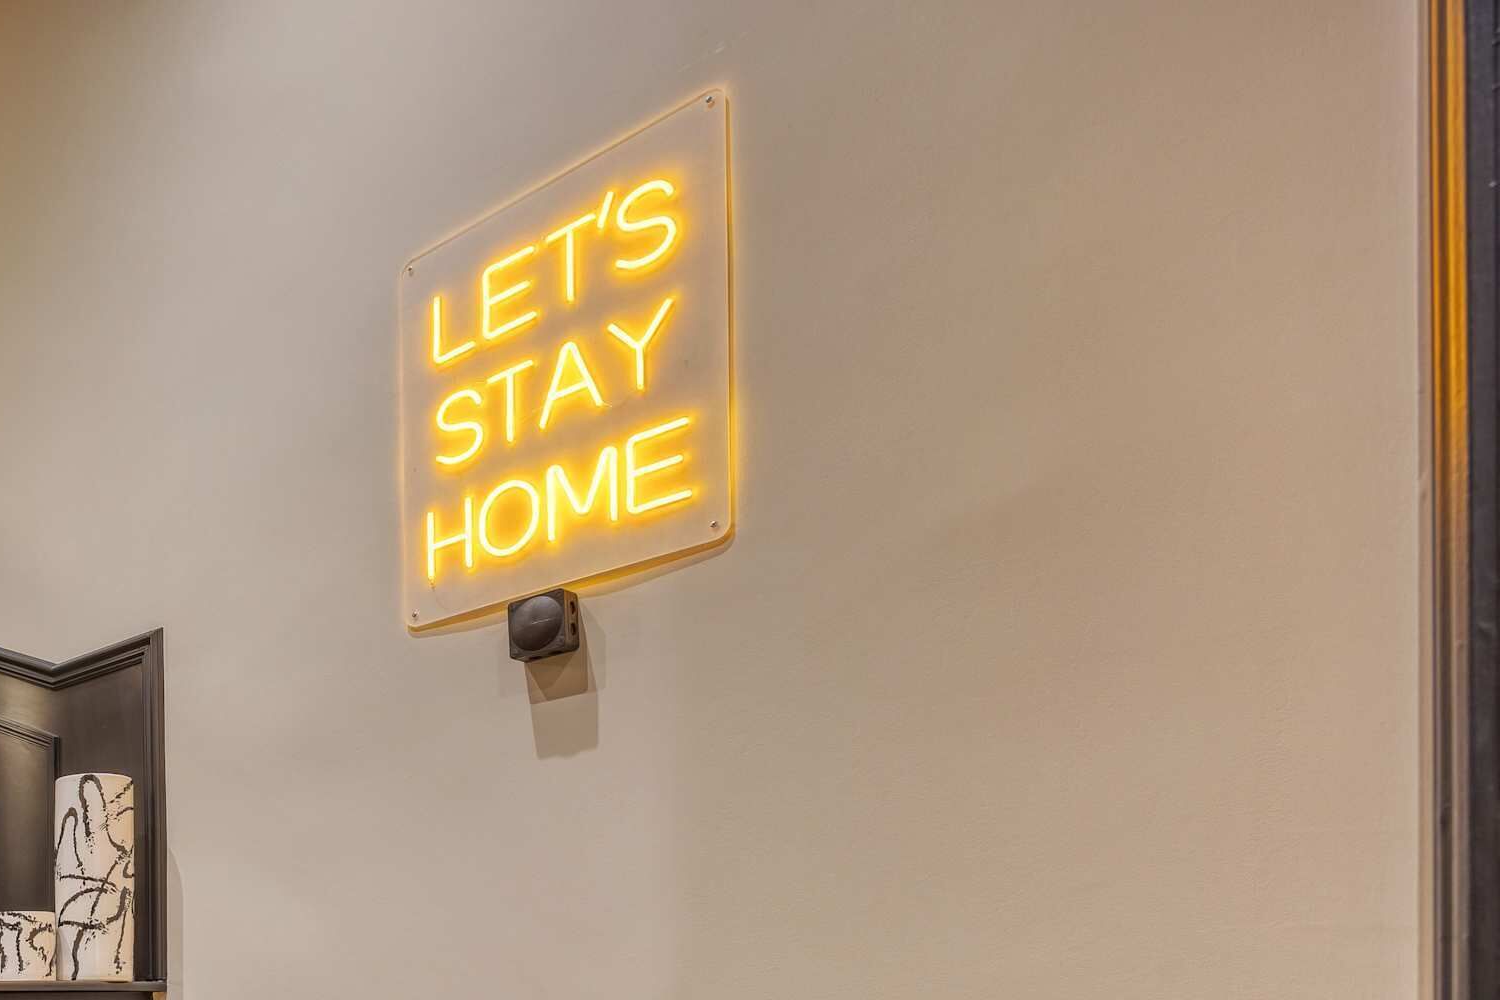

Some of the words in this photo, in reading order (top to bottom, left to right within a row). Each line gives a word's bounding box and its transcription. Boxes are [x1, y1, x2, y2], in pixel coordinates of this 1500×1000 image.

[431, 178, 678, 365] LET'S
[434, 297, 675, 466] STAY
[425, 415, 694, 581] HOME
